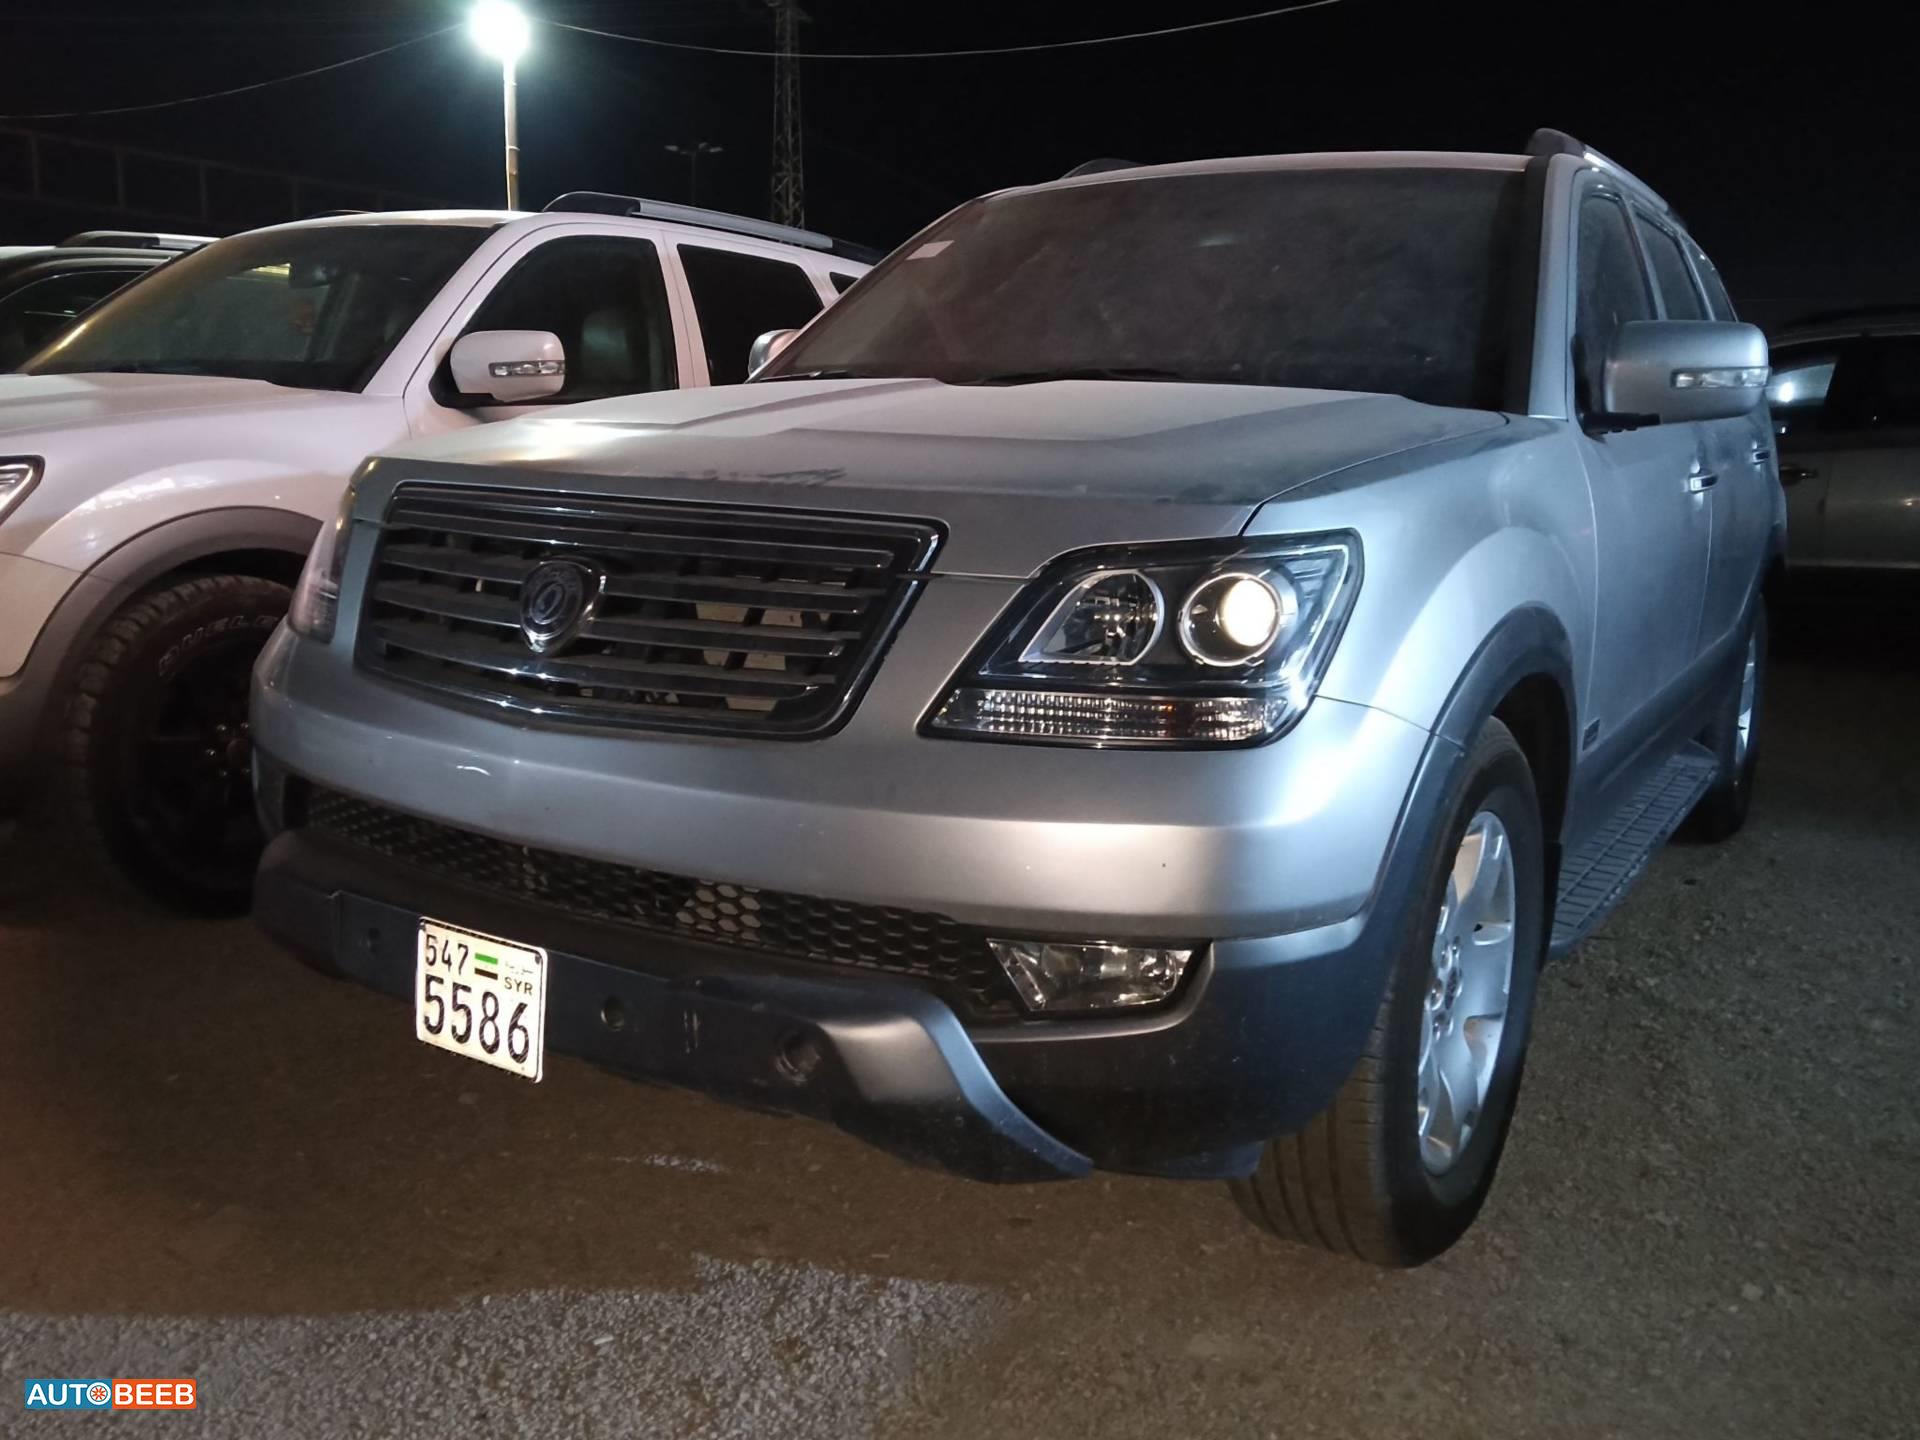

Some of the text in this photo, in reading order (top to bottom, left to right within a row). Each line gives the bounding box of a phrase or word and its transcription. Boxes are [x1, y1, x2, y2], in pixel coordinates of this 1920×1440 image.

[425, 934, 469, 976] 547
[504, 976, 533, 996] SYR
[424, 973, 530, 1064] 5586
